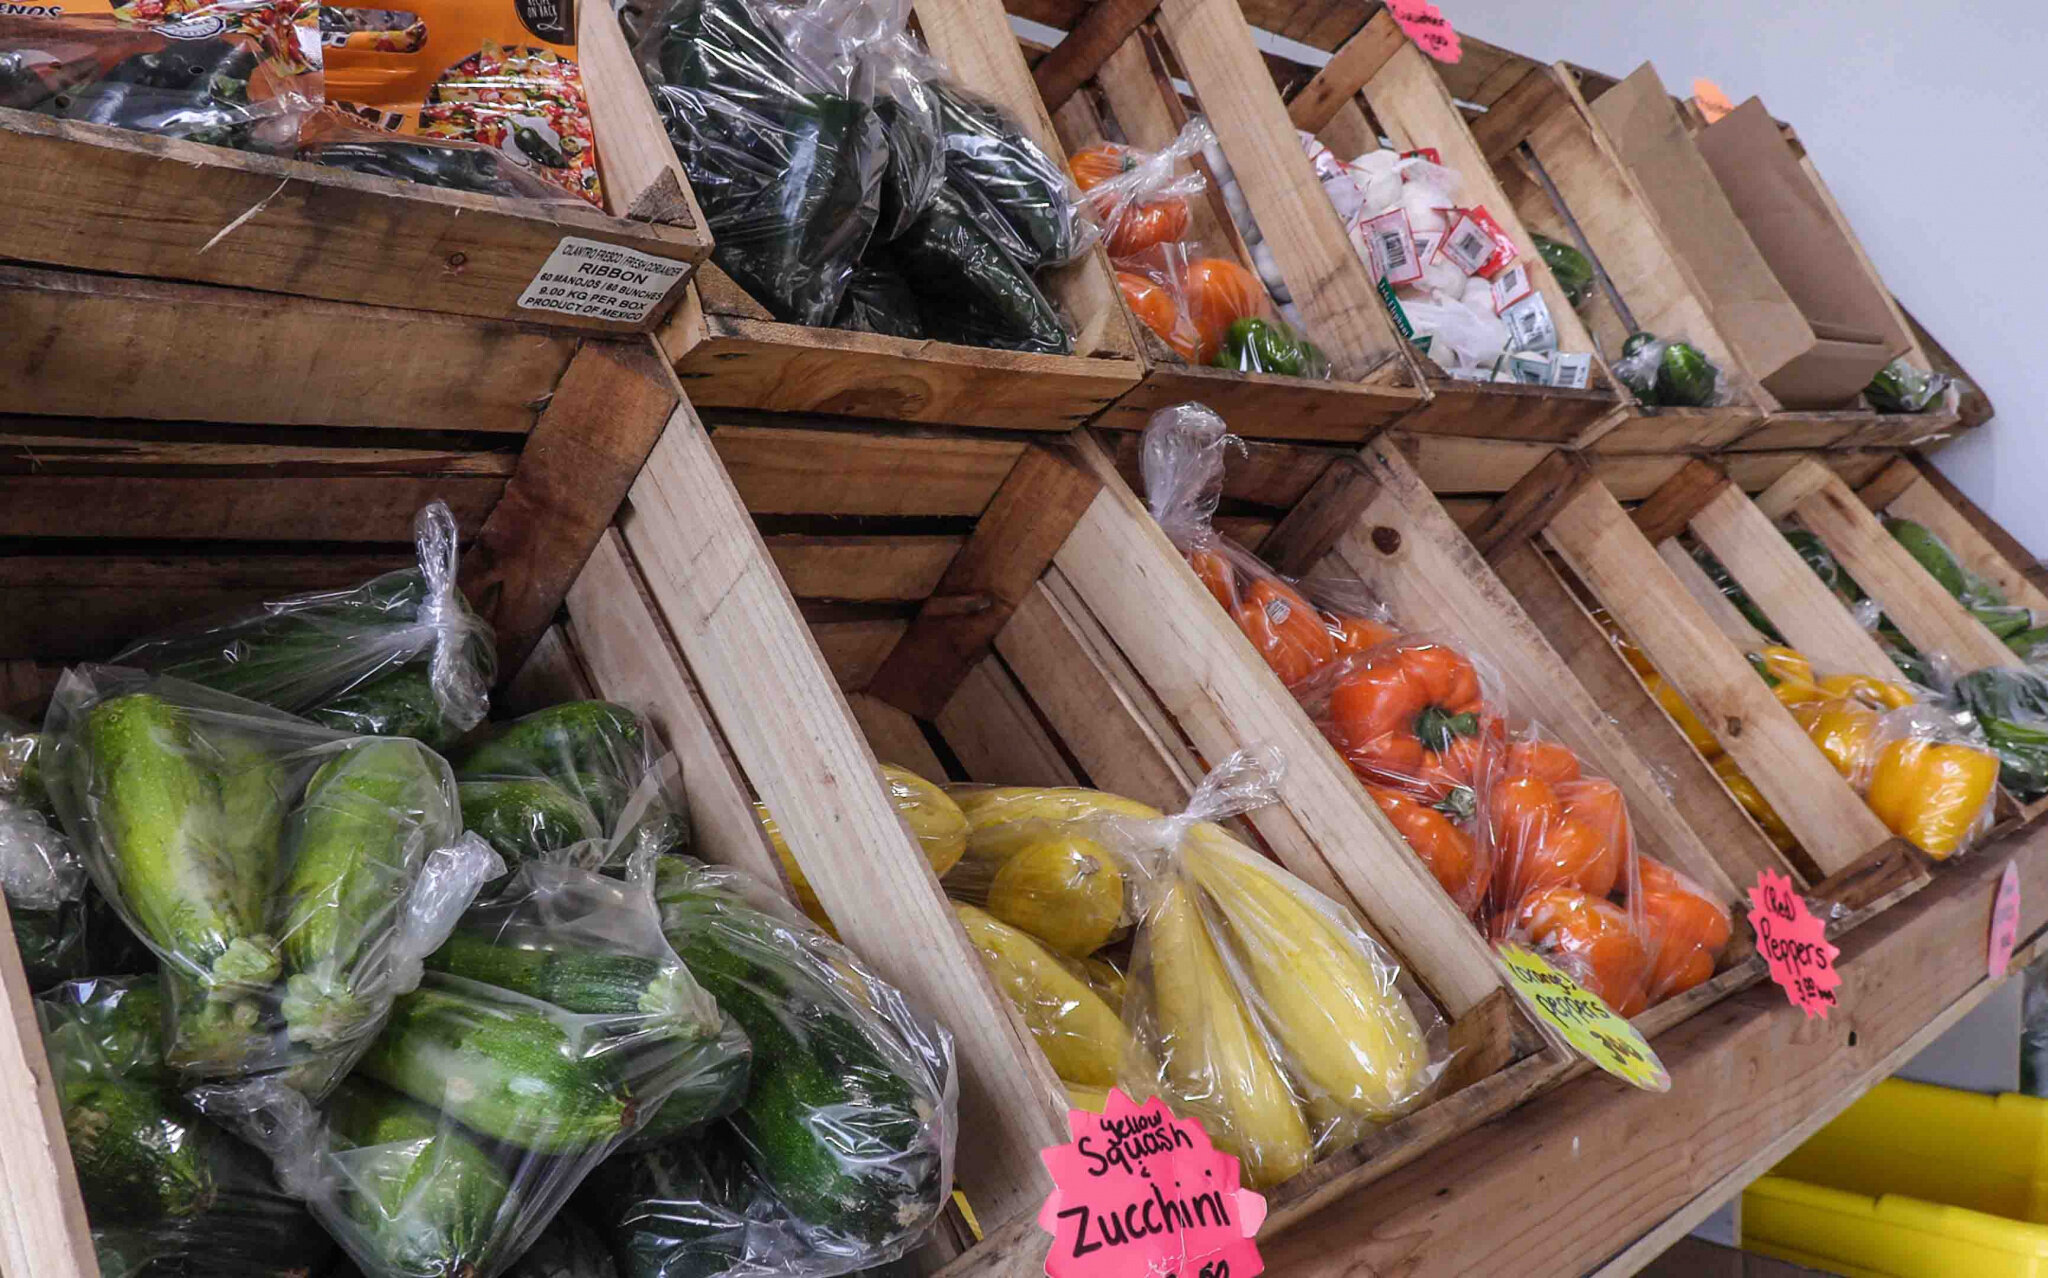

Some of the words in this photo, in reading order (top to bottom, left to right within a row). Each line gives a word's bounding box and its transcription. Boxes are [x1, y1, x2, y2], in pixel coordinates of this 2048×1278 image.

[562, 244, 597, 260] CILANTRO
[594, 250, 624, 264] FRESCO
[625, 256, 647, 270] FRESH
[645, 260, 683, 276] CORIANDER
[578, 262, 649, 285] RIBBON
[539, 286, 565, 297] 9.00
[567, 290, 588, 301] KG
[590, 294, 616, 306] PER
[620, 299, 649, 311] BOX
[540, 273, 552, 282] 60
[552, 274, 601, 289] MANOJOS
[606, 283, 617, 292] 60
[619, 286, 663, 301] BUNCHES
[525, 296, 583, 312] PRODUCT
[583, 305, 599, 316] OF
[600, 308, 643, 321] MEXICO
[1760, 916, 1827, 976] Peppers
[1078, 1122, 1194, 1177] Squash
[1057, 1169, 1231, 1258] Zucchini
